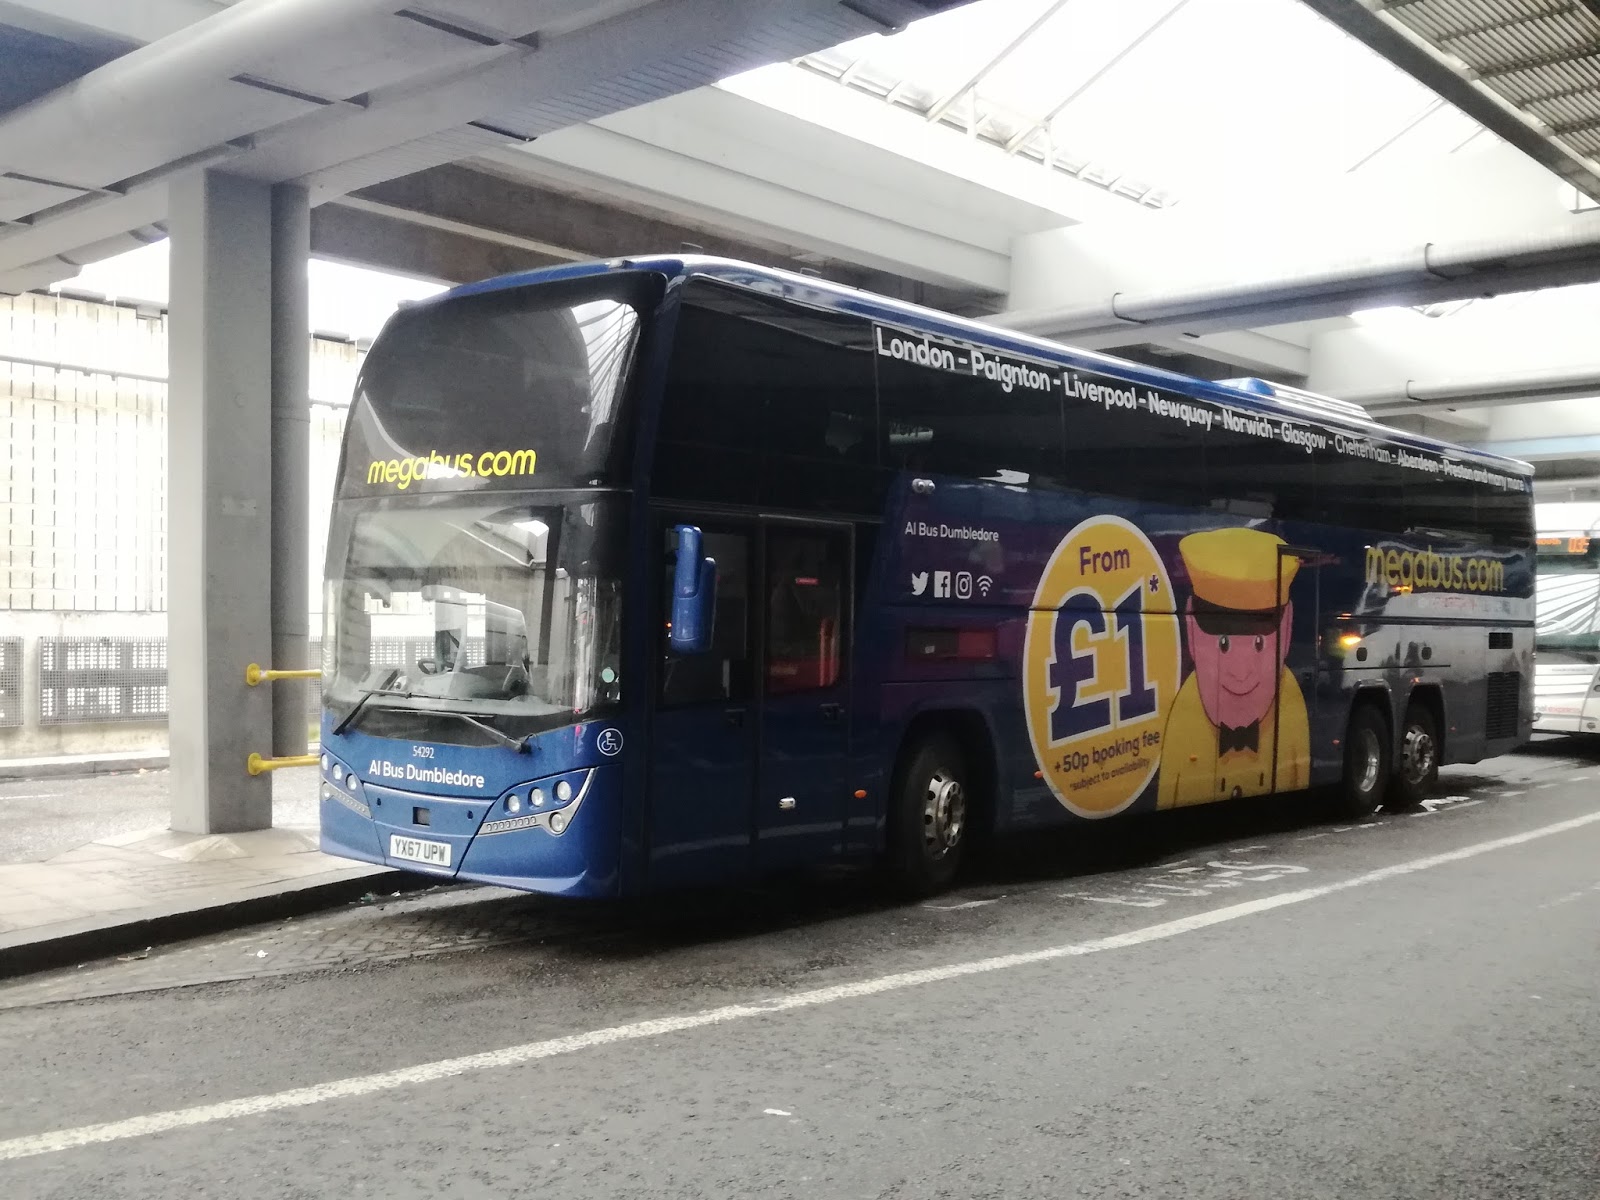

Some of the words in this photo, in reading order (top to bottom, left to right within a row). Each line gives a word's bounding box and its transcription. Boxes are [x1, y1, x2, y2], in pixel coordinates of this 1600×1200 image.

[876, 327, 956, 370] London
[970, 350, 1051, 393] Paignton
[1064, 372, 1138, 411] Liverpool
[1148, 391, 1214, 432] Newquay
[1222, 409, 1274, 438] Norwich
[1281, 422, 1327, 454] Glasgow
[1335, 433, 1391, 464] Cheltenham
[367, 449, 537, 490] megabus.com
[918, 522, 939, 538] Bus
[940, 524, 1000, 542] Dumbledore
[1080, 545, 1131, 576] From
[1365, 544, 1504, 594] megabus.com
[412, 745, 435, 760] 54292
[1092, 737, 1140, 763] booking
[1142, 731, 1160, 747] fee
[382, 762, 405, 779] Bus
[406, 764, 485, 788] Dumbledore
[394, 838, 423, 857] YX67
[423, 843, 447, 862] UPW
